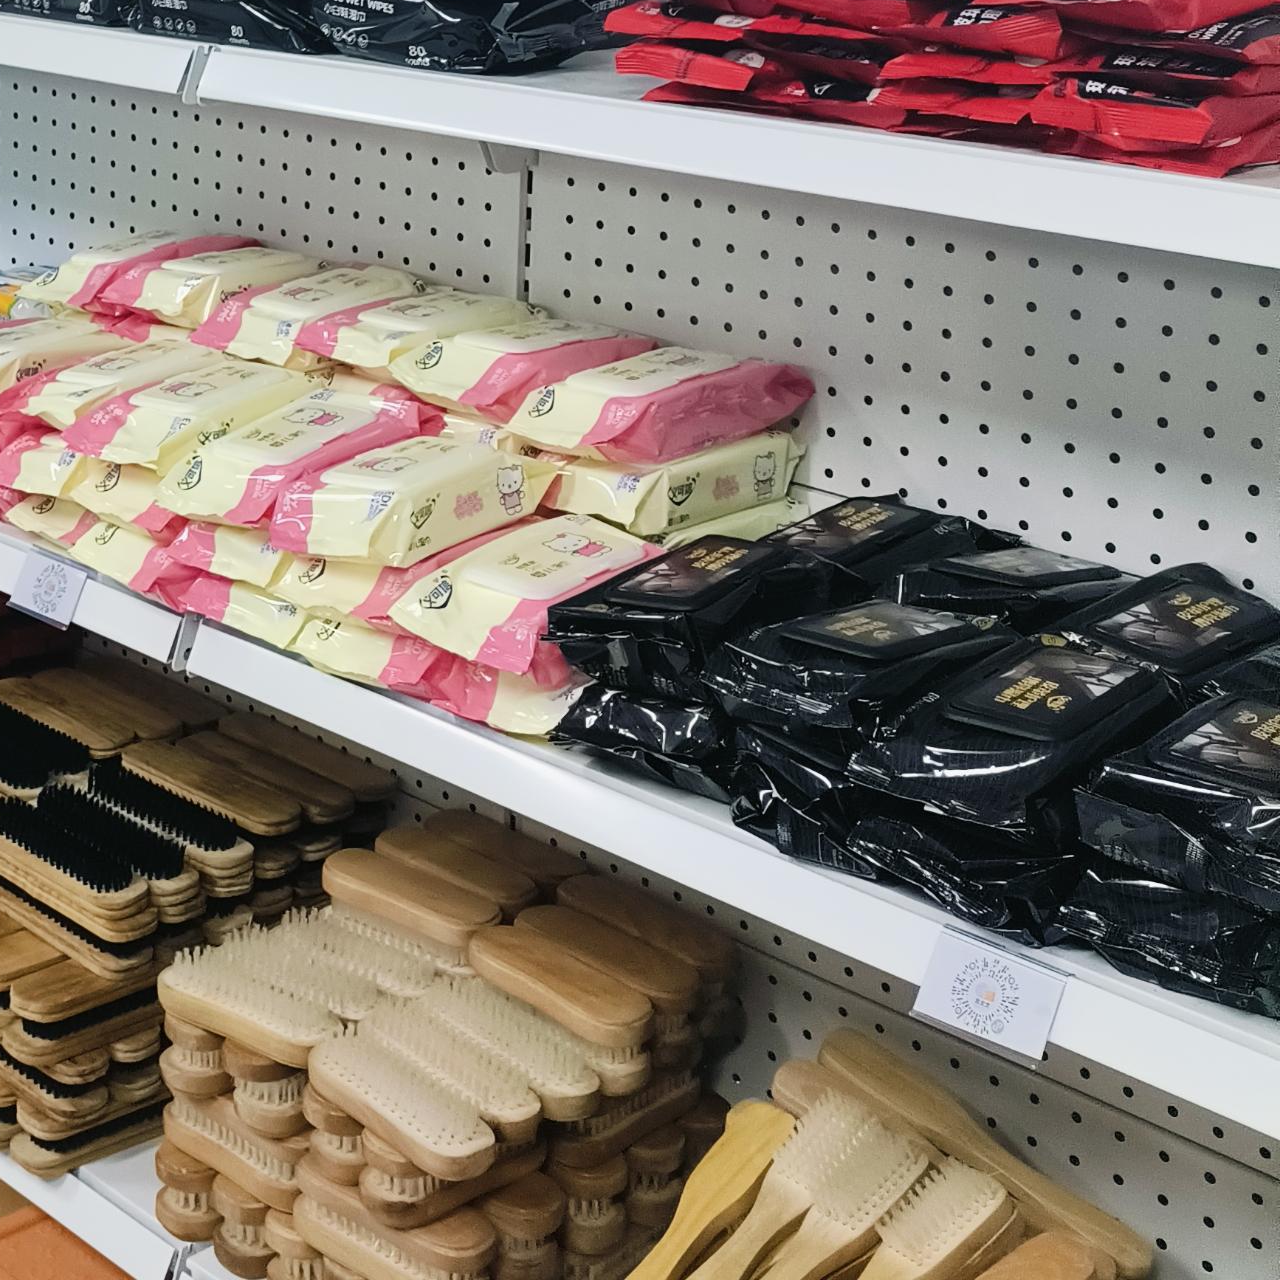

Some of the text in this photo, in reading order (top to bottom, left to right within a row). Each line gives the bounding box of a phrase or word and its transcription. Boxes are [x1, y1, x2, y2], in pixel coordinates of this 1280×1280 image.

[367, 0, 395, 14] WIPES
[230, 25, 244, 37] 80
[408, 45, 426, 57] 80
